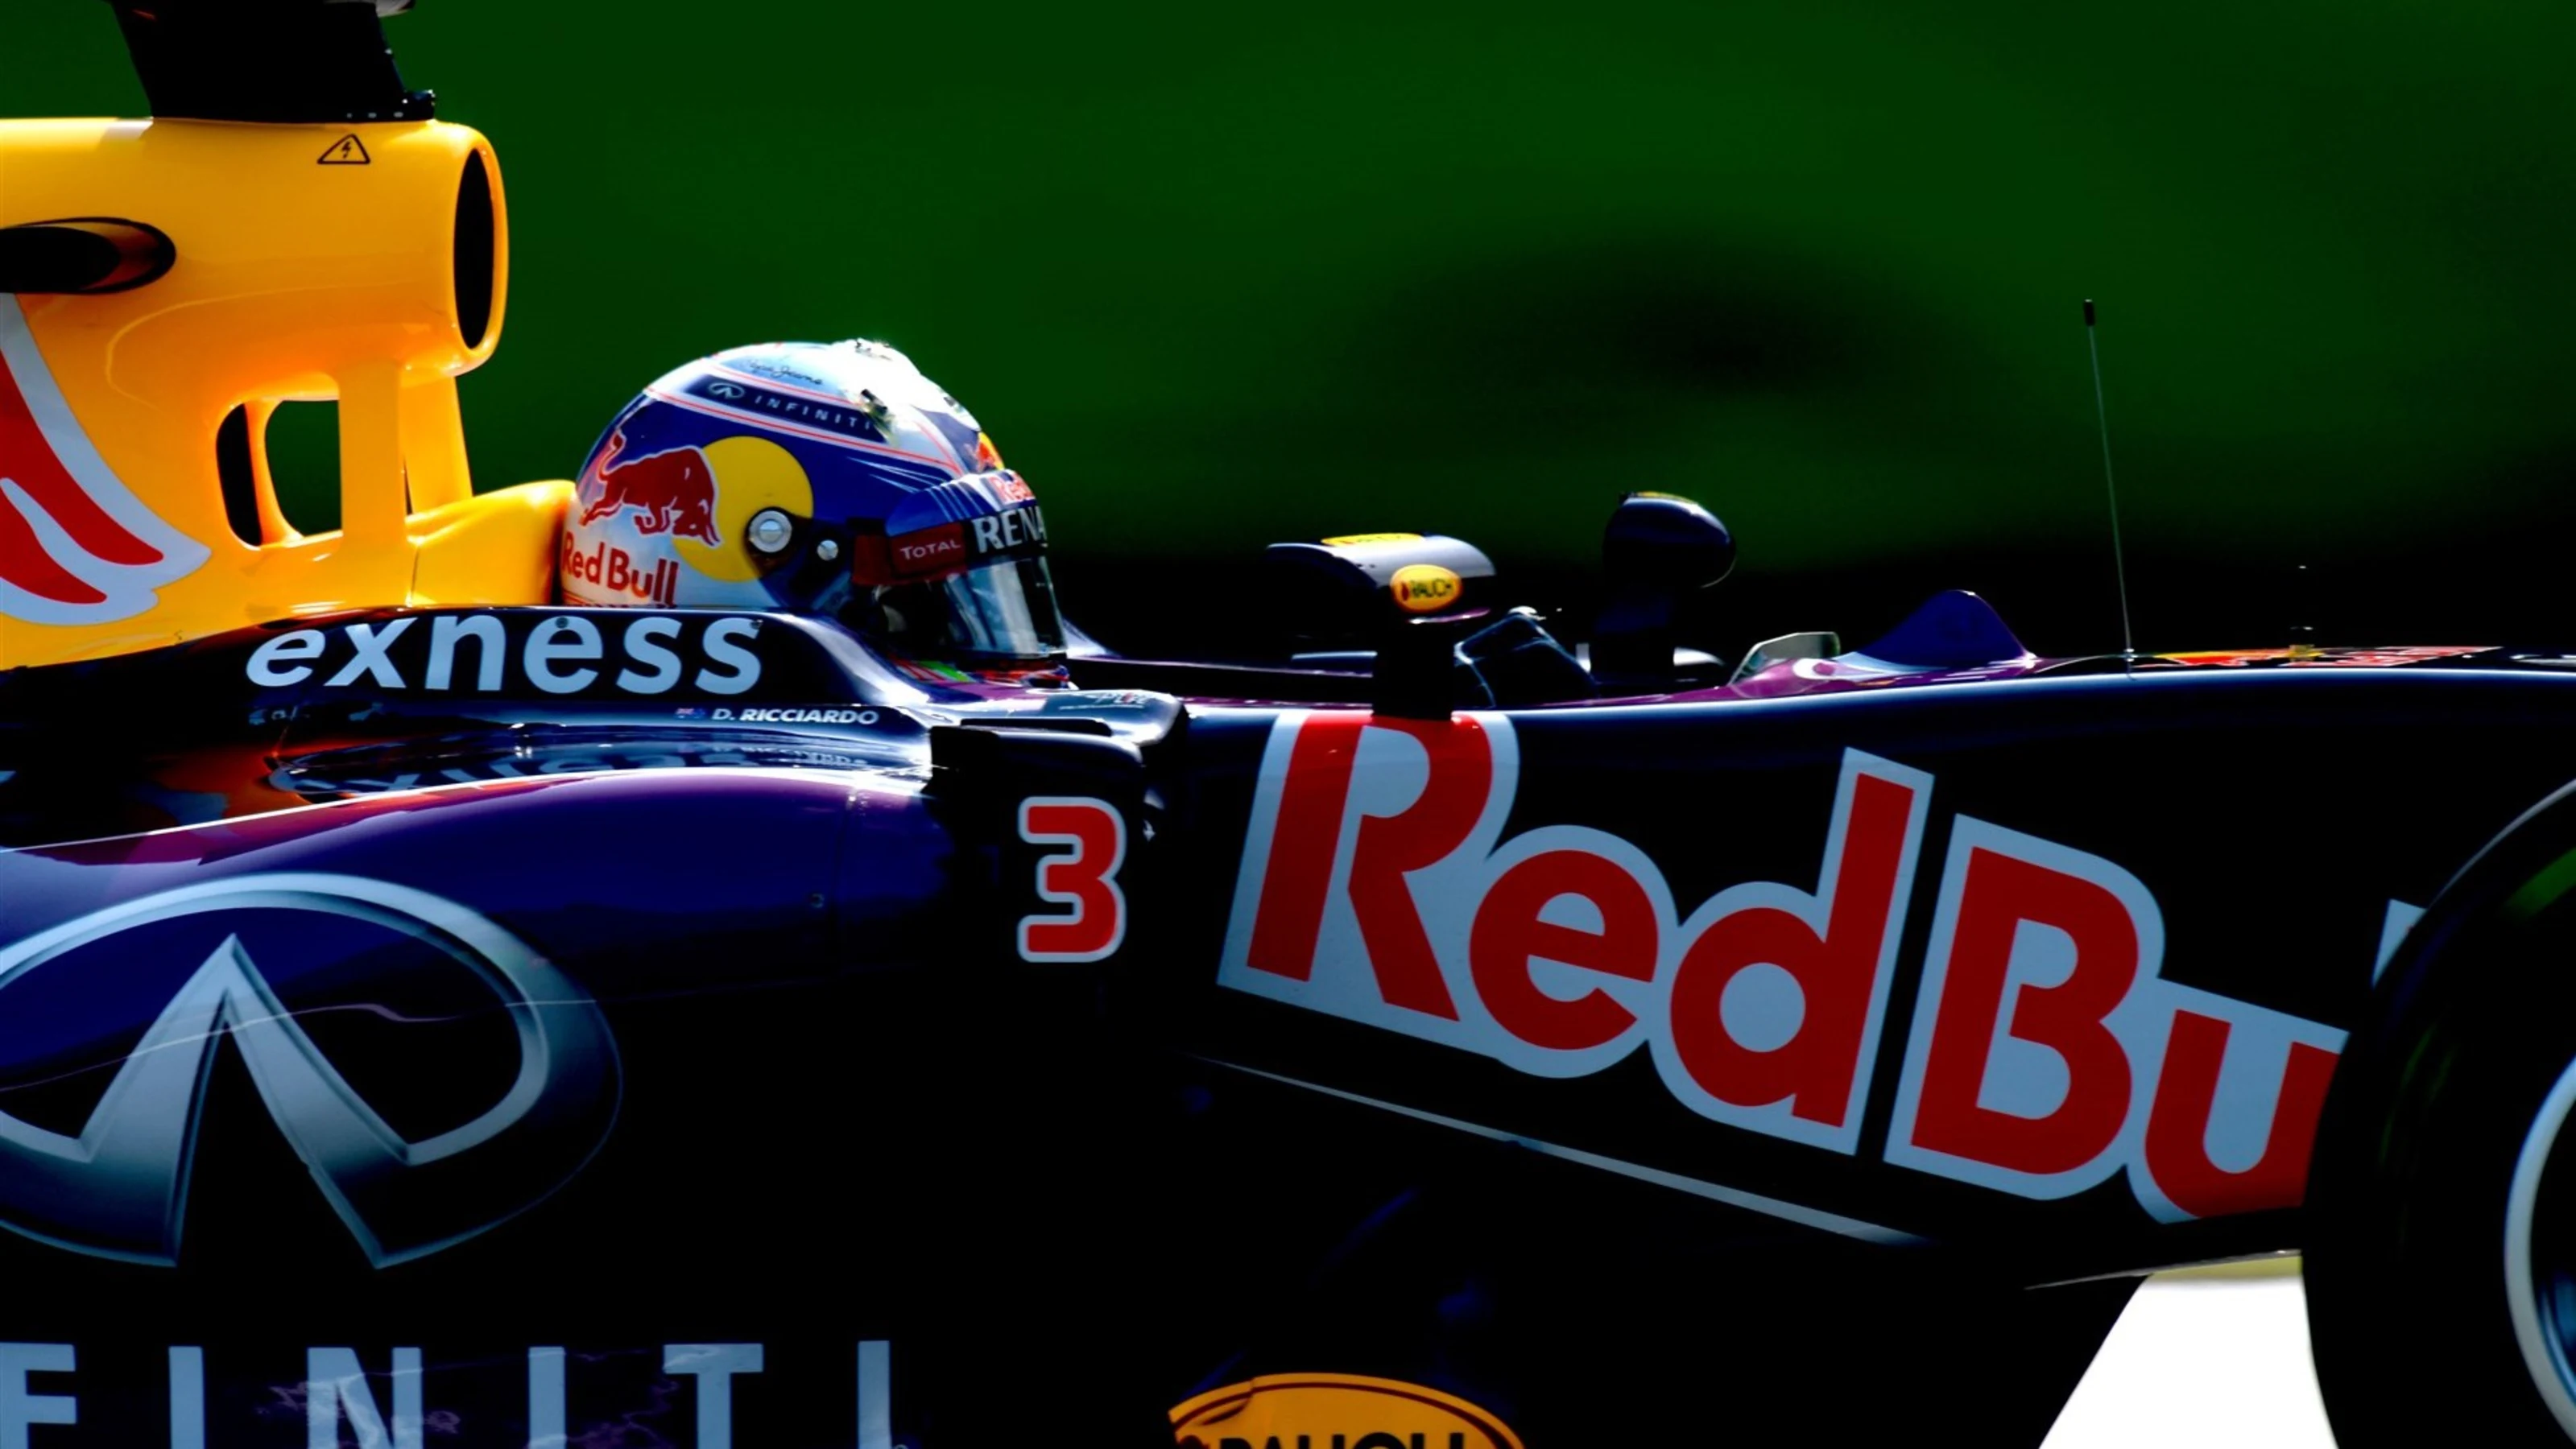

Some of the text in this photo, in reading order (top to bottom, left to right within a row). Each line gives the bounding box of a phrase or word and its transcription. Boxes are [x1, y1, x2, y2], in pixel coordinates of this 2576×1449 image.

[755, 394, 870, 431] INFINITI
[562, 531, 679, 606] Red Bull
[900, 539, 961, 560] TOTAL
[246, 614, 763, 695] exness
[712, 708, 879, 724] D. RICCIARDO
[1017, 795, 1127, 963] 3
[1245, 710, 1916, 1129] Red
